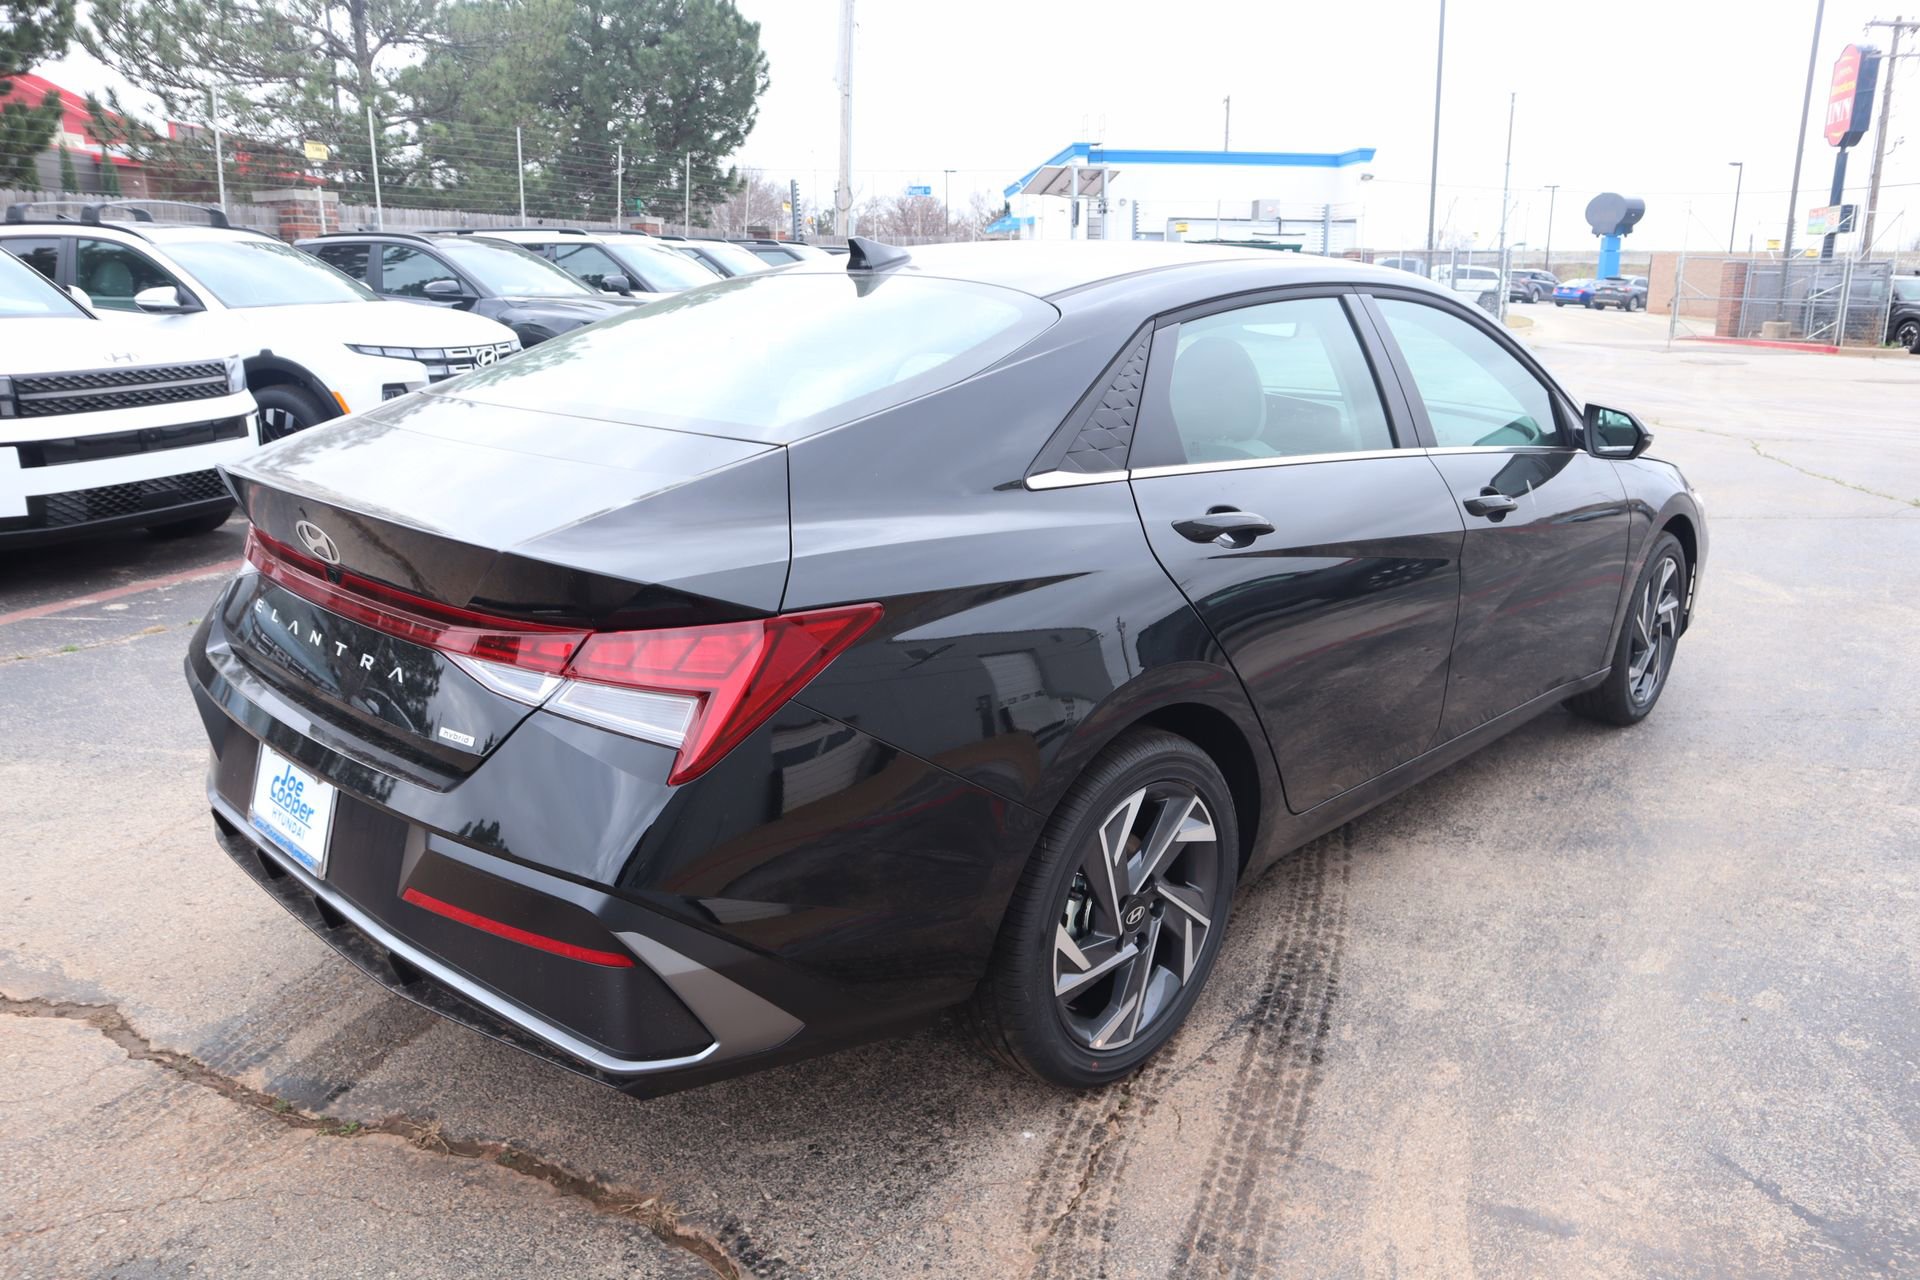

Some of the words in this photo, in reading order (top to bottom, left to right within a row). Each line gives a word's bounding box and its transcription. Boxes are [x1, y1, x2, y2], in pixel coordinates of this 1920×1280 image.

[1828, 97, 1851, 125] INN
[255, 598, 403, 683] ELANTRA
[442, 729, 470, 744] hybrid
[281, 764, 304, 797] Joe
[270, 775, 315, 823] Cooper
[271, 807, 306, 841] HYUNDAI
